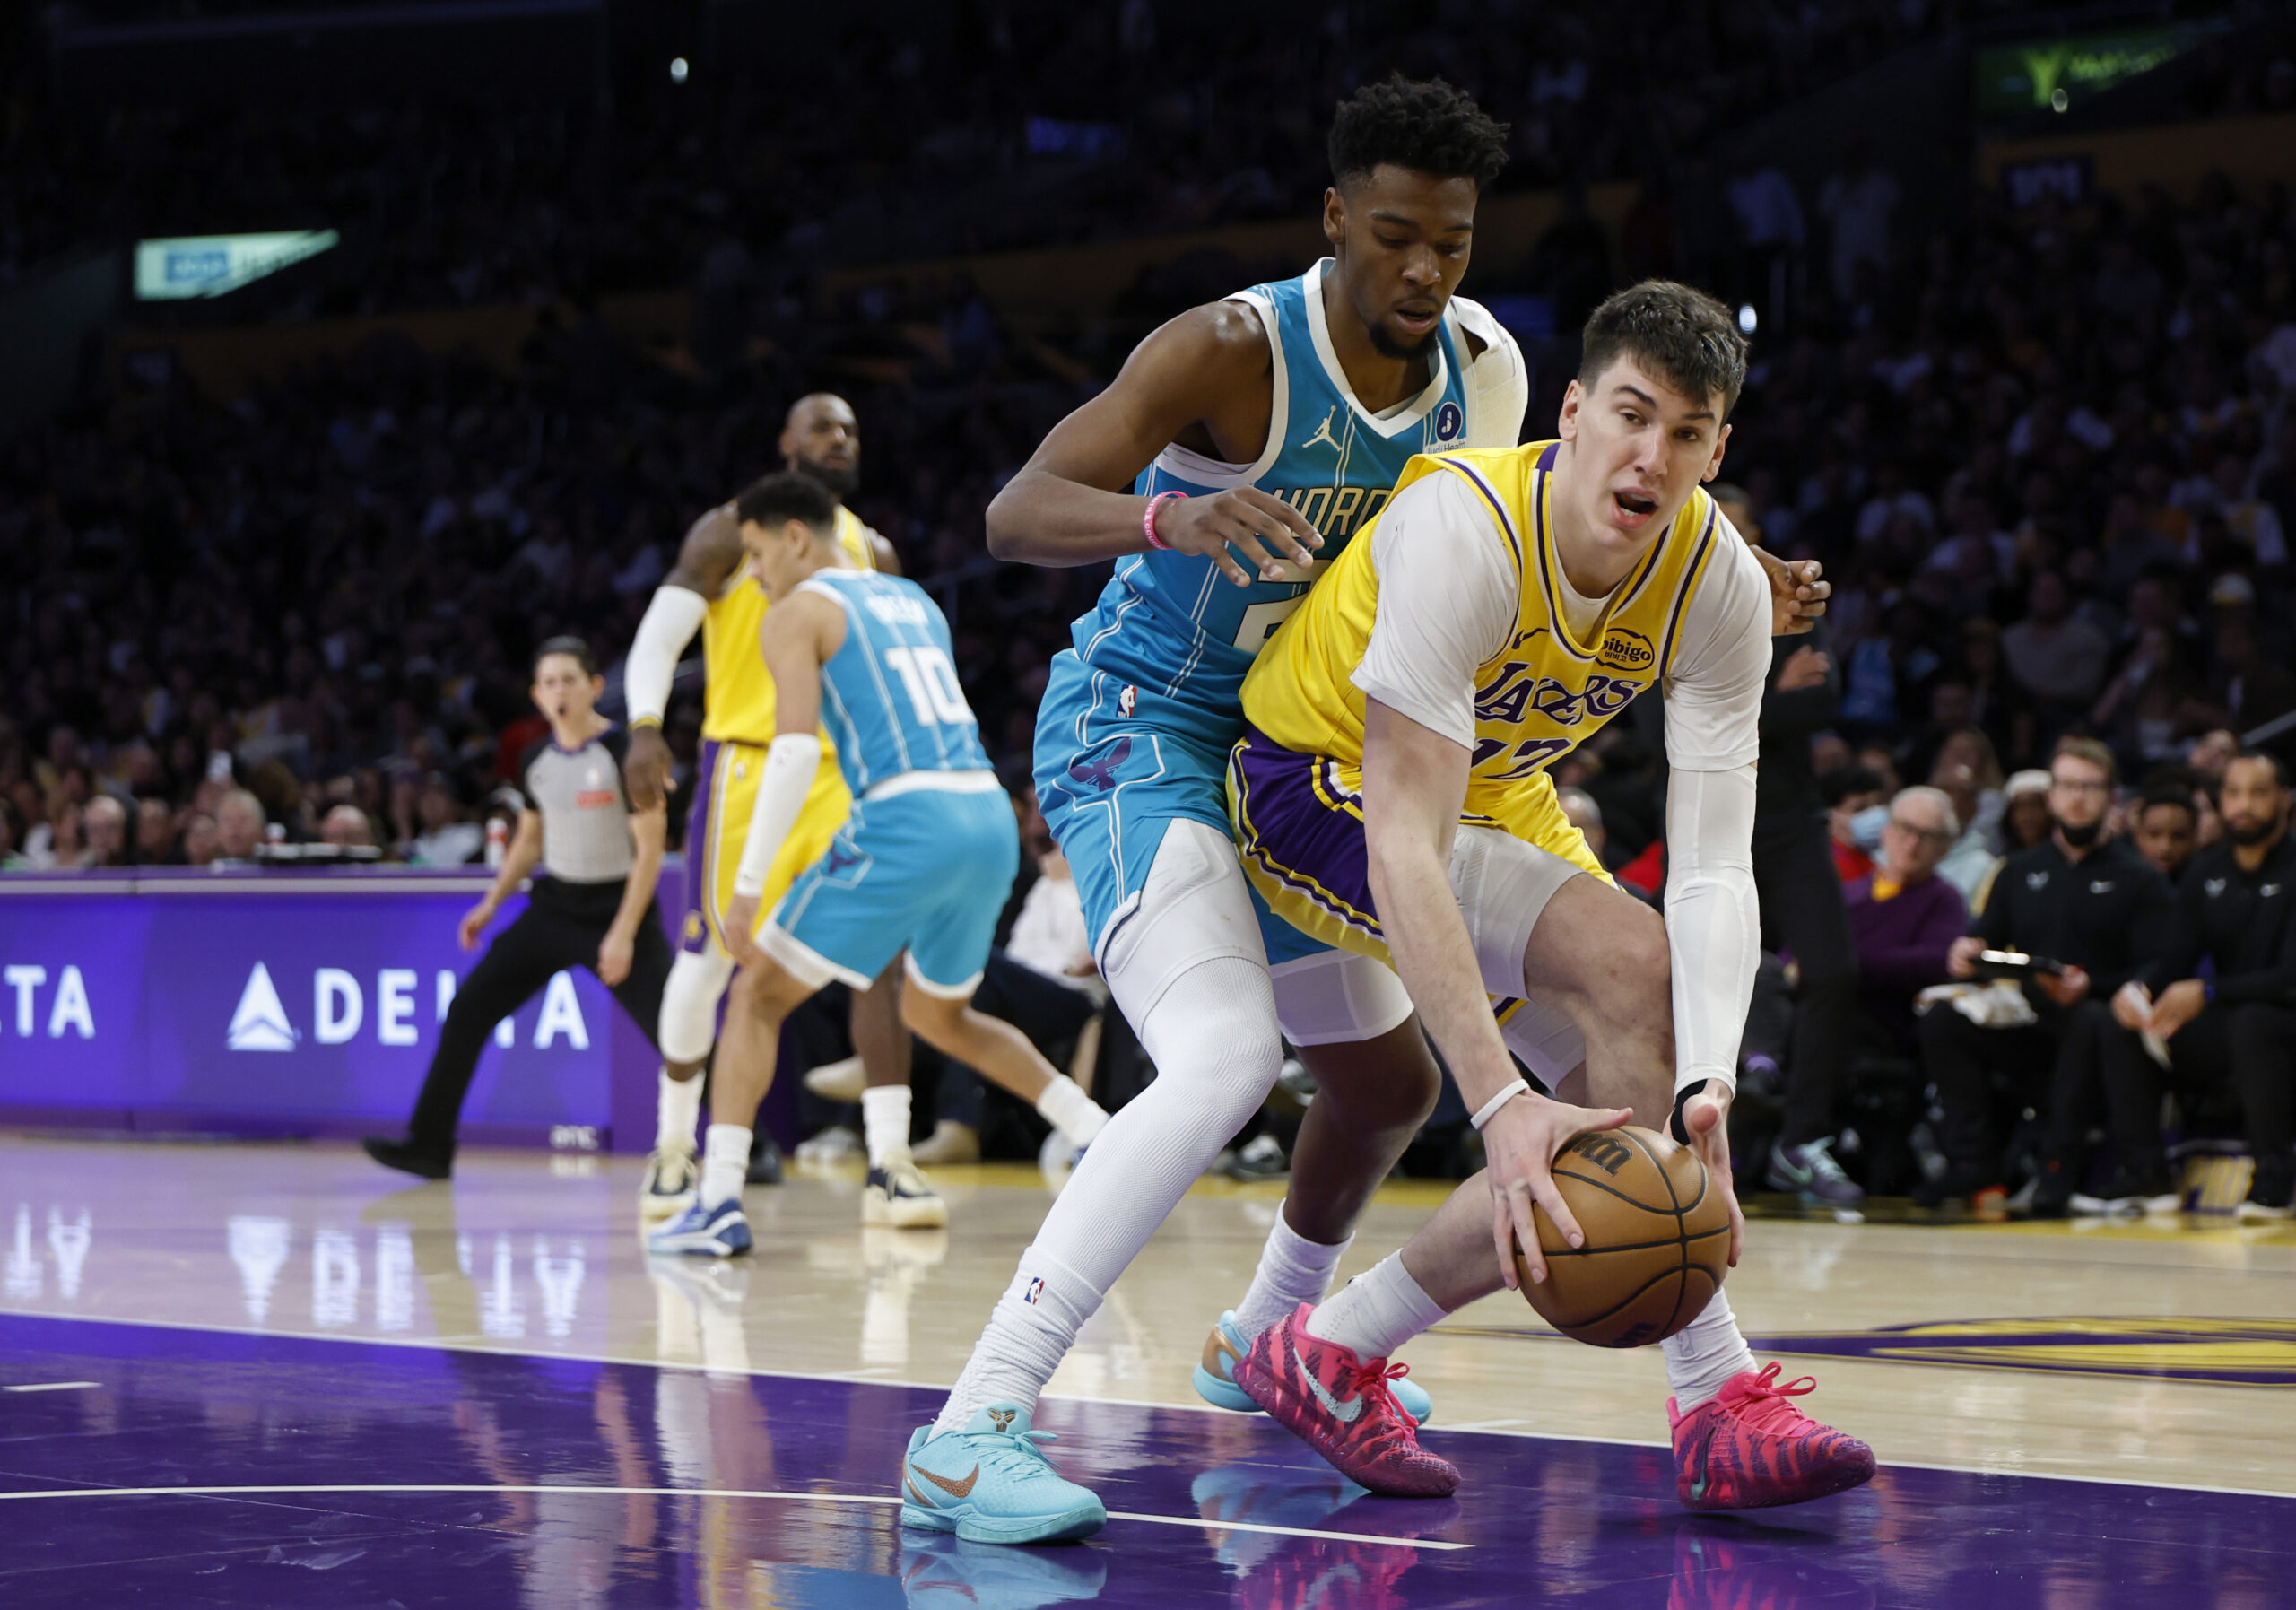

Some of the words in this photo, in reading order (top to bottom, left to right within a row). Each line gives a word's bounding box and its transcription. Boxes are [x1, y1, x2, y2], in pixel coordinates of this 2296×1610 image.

[883, 644, 978, 727] 10
[0, 963, 96, 1040] TA
[313, 967, 590, 1050] DEA
